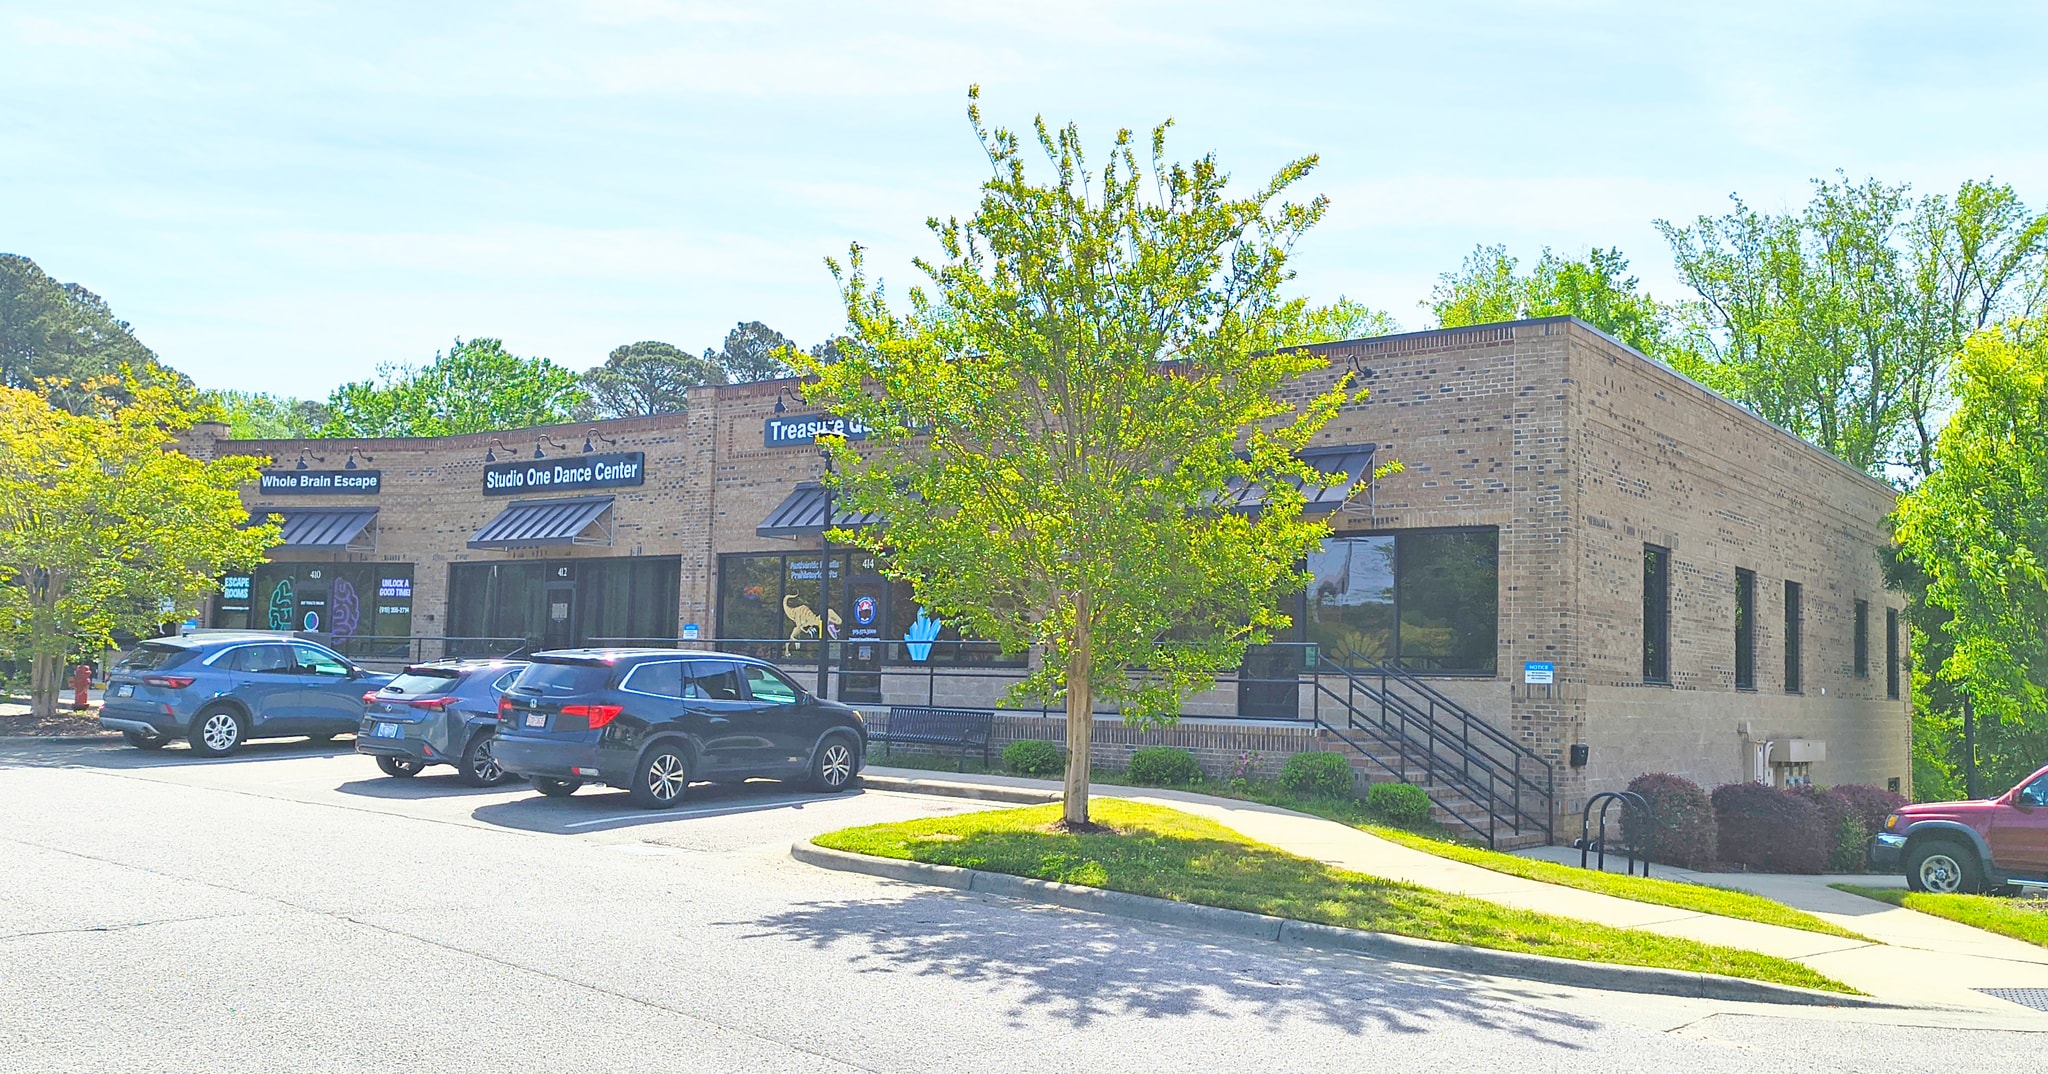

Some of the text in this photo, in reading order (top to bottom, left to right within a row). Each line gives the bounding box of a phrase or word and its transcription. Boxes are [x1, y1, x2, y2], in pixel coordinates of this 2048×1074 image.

[487, 461, 638, 489] Studio One Dance Center
[262, 475, 377, 489] Whole Brain Escape
[862, 558, 874, 569] 414
[310, 570, 321, 579] 410
[558, 567, 568, 577] 412
[224, 577, 250, 587] ESCAPE
[382, 579, 410, 588] UNLOCK A
[224, 588, 249, 598] ROOMS
[379, 588, 395, 597] GOOD
